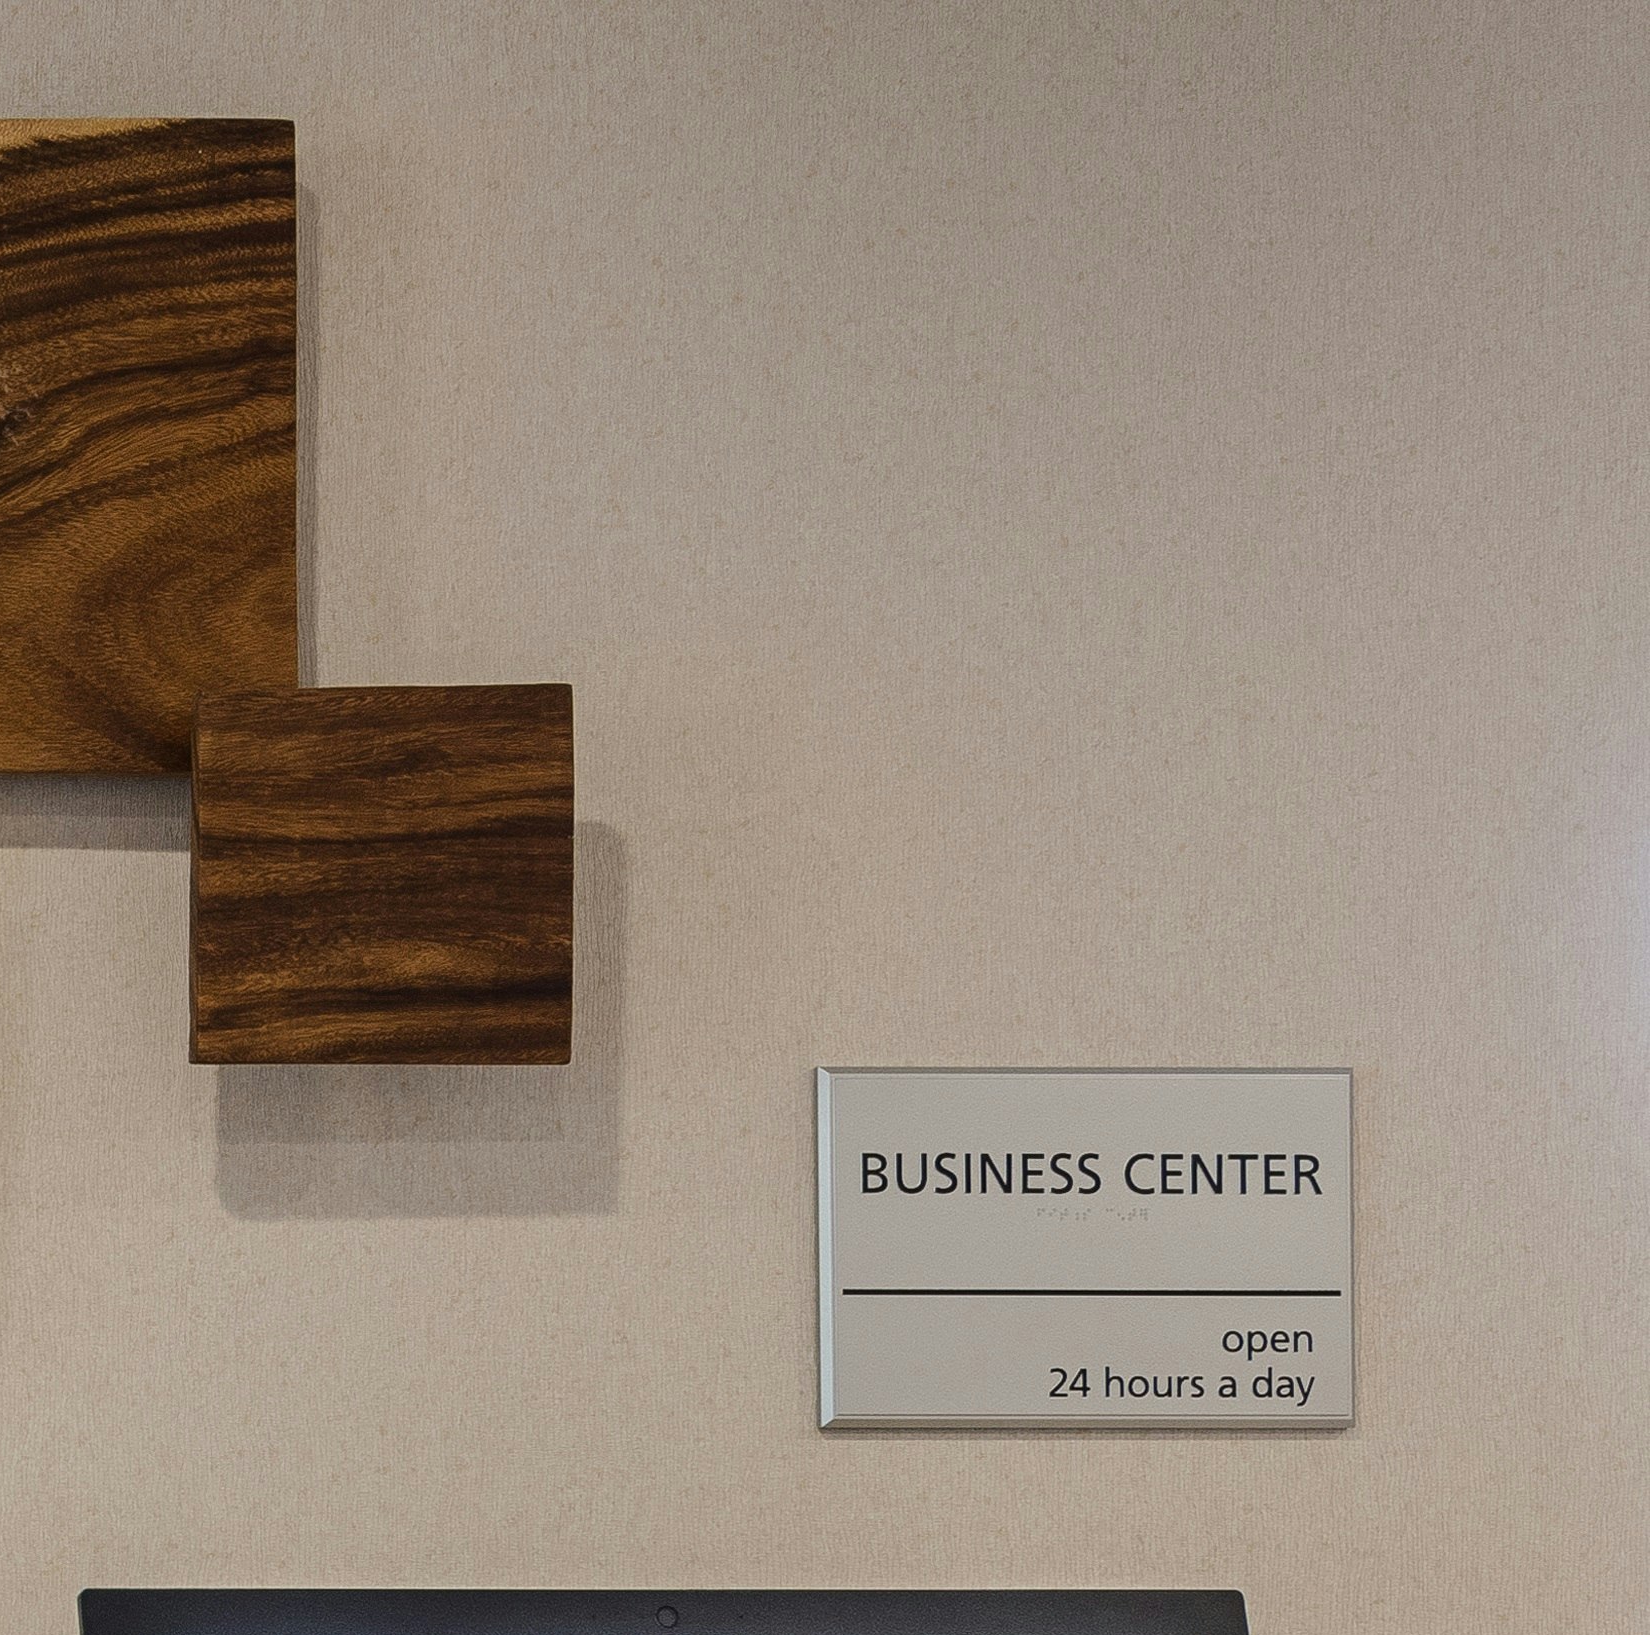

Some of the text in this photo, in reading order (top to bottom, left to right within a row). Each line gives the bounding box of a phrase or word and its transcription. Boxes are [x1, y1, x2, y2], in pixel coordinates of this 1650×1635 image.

[860, 1152, 1323, 1196] BUSINESS CENTER
[1221, 1329, 1315, 1361] open
[1049, 1366, 1316, 1406] 24 hours a day
